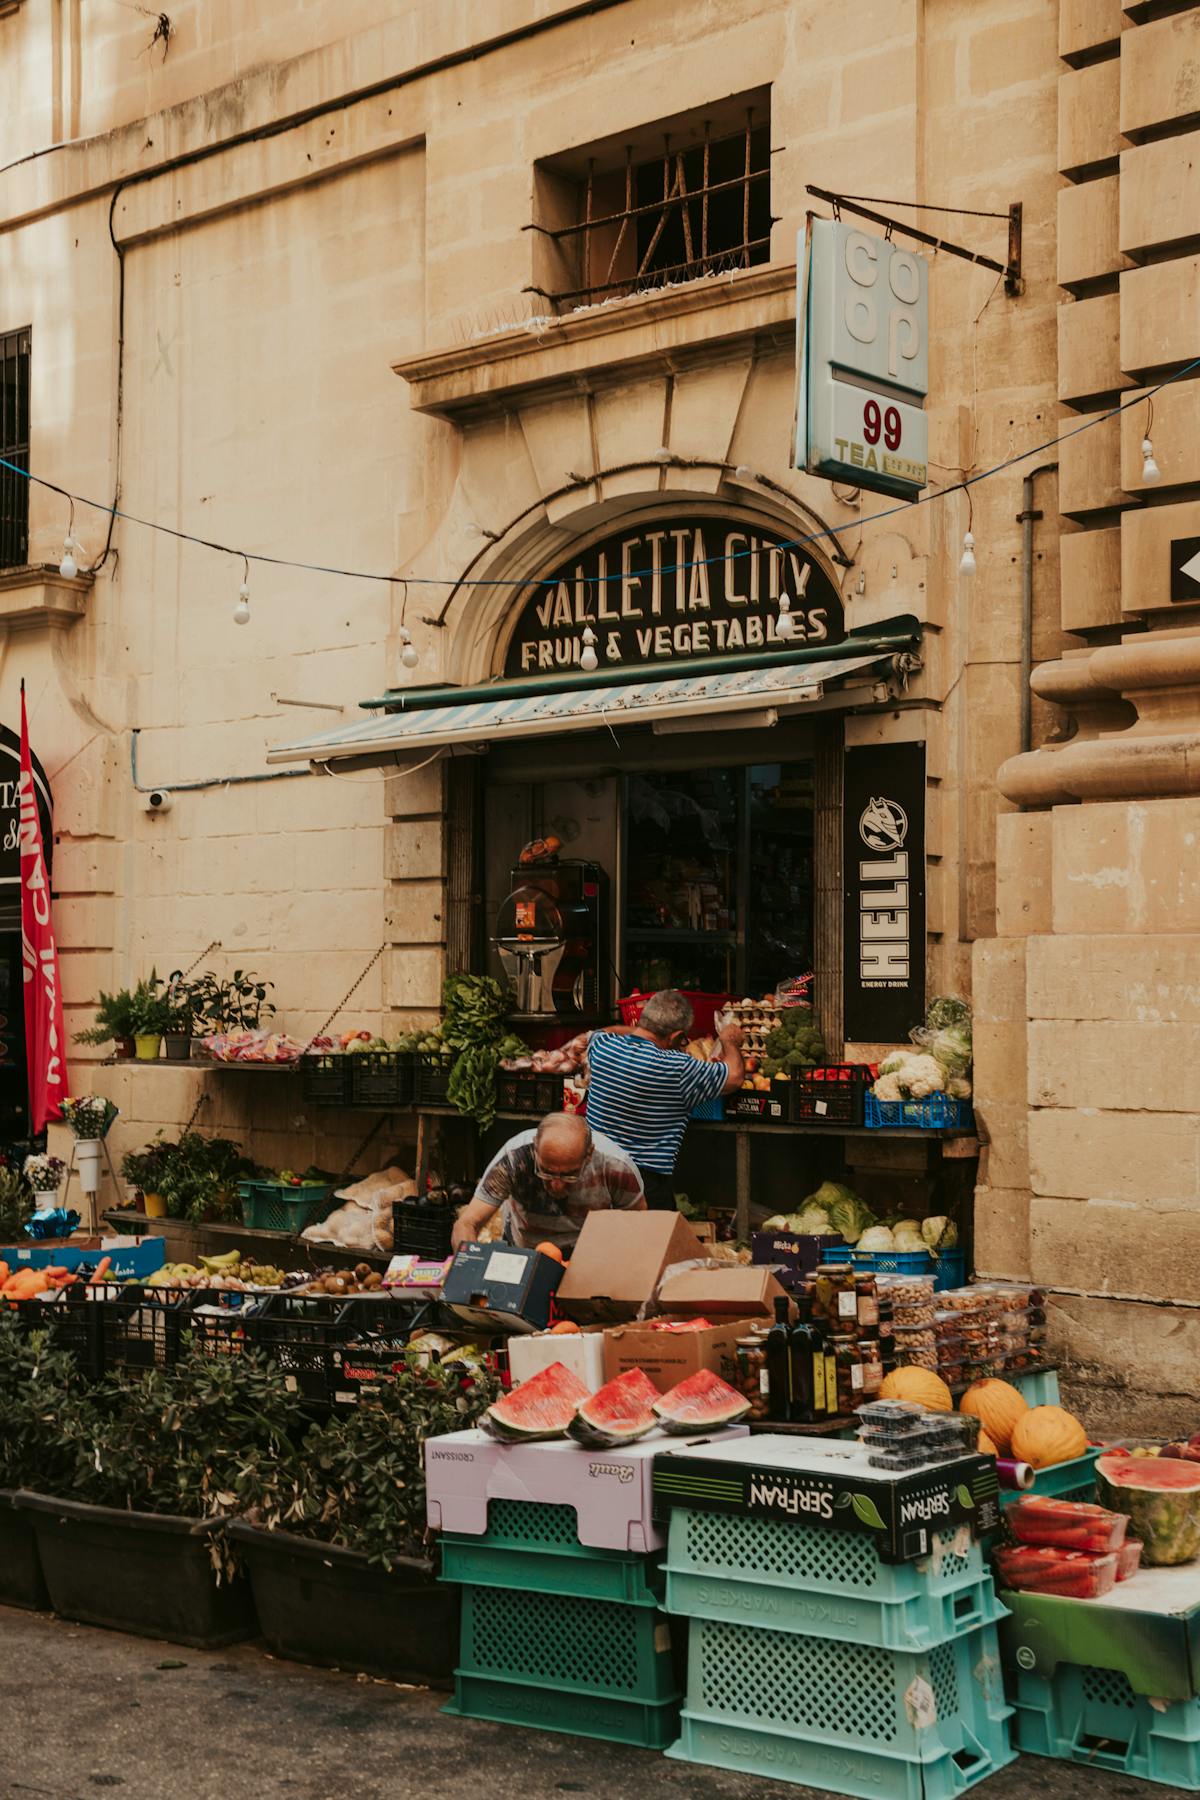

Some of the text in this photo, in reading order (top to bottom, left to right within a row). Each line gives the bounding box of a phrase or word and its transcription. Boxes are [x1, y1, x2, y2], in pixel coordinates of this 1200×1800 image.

[863, 400, 902, 451] 99
[834, 438, 879, 472] TEA
[536, 527, 812, 630] VALLETTA CITY
[521, 607, 828, 672] FRUI & VEGETABLES
[859, 851, 910, 979] HELL
[431, 1450, 475, 1462] CROISSANT
[590, 1462, 635, 1484] Bauli
[698, 1585, 781, 1614] MARKETS
